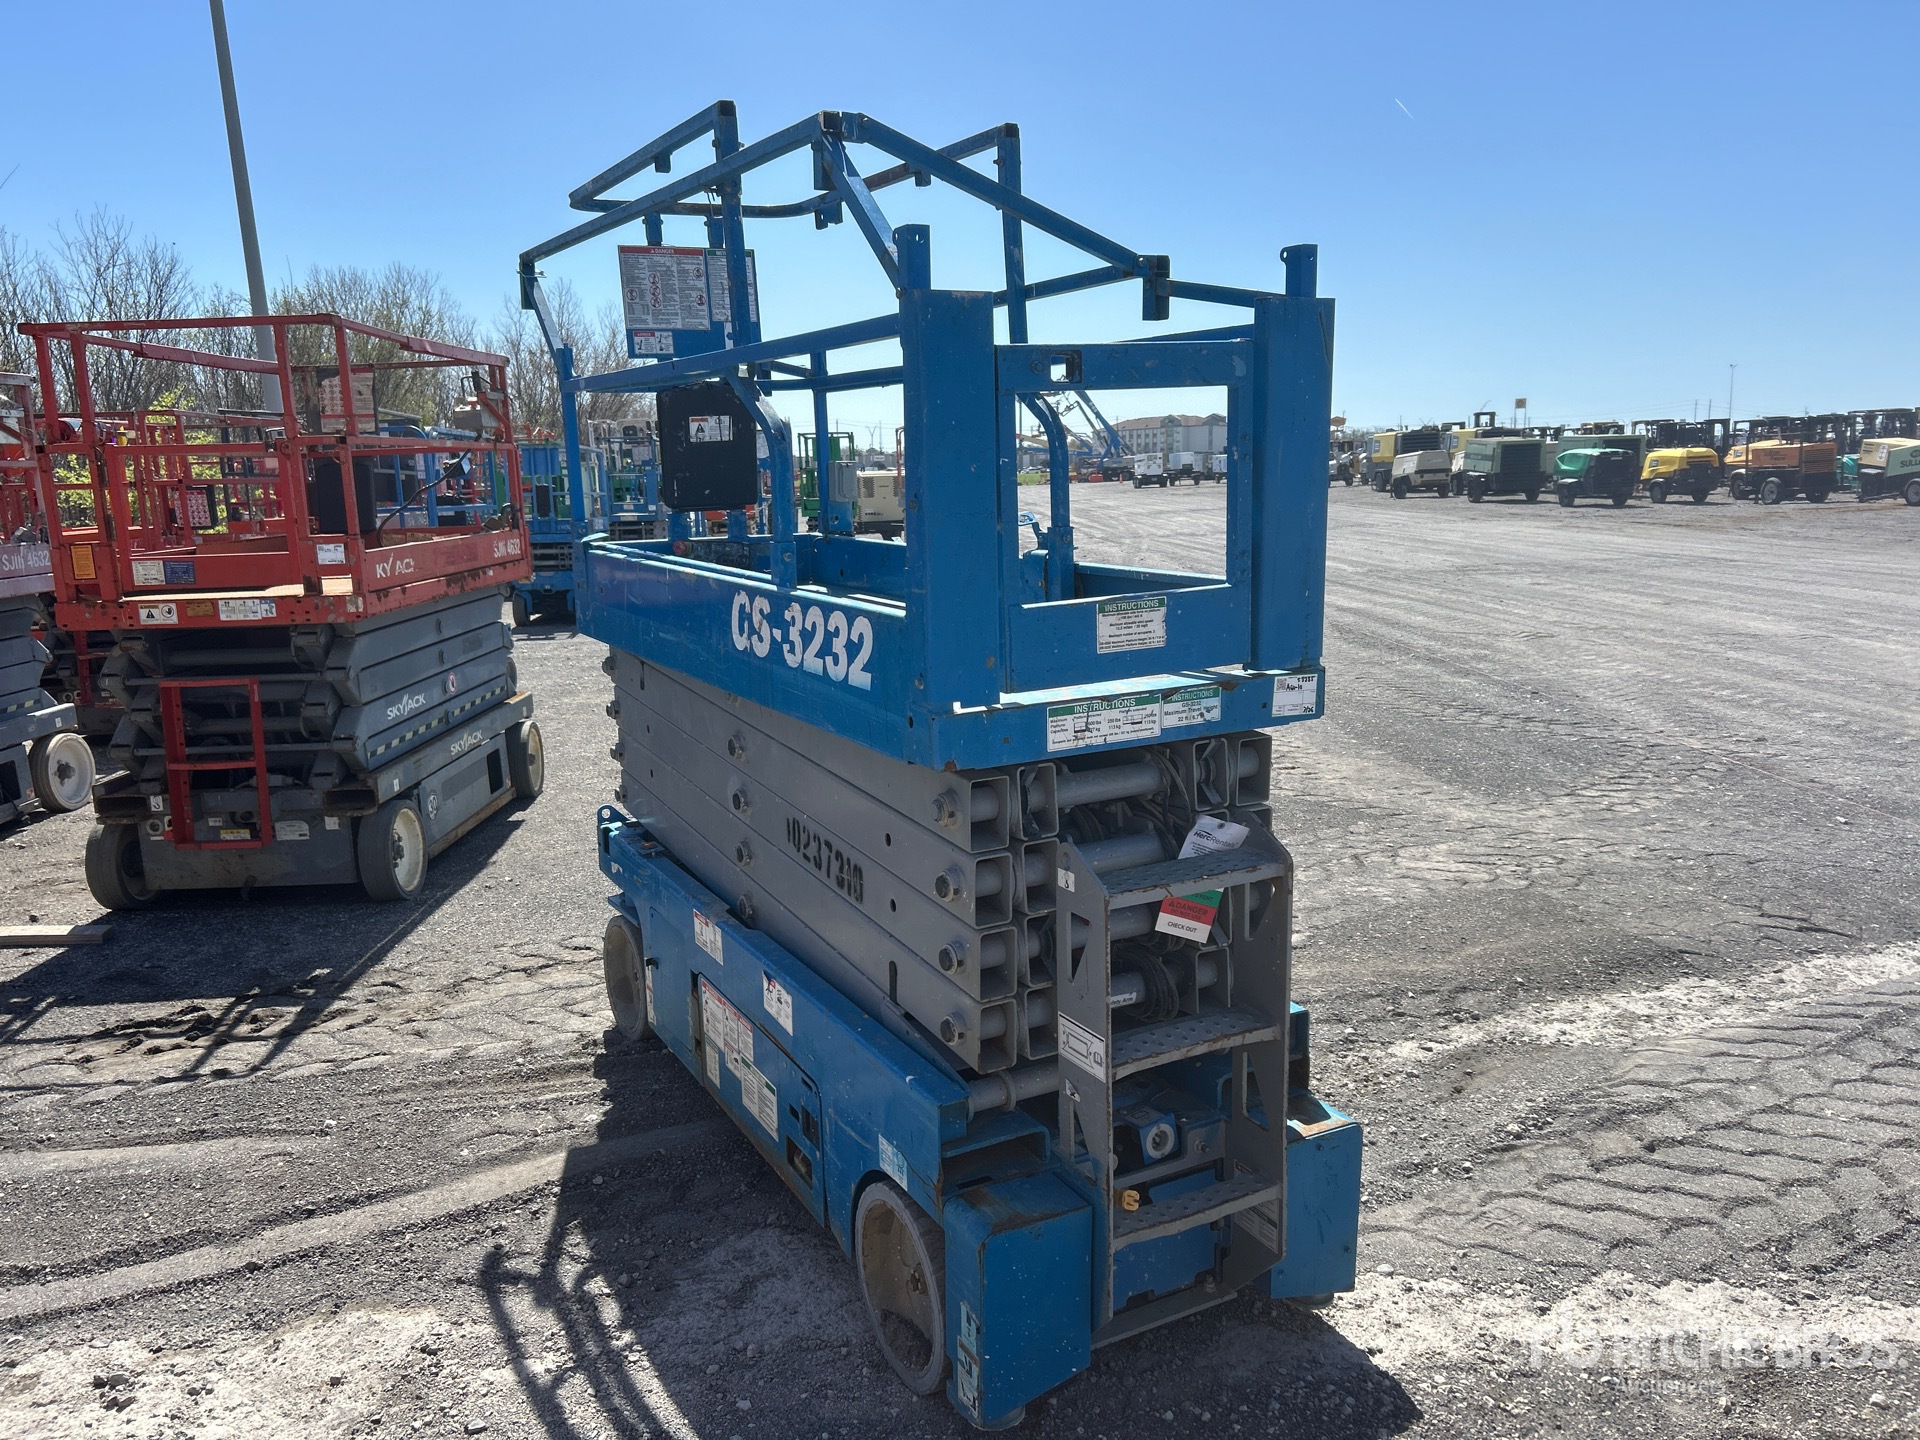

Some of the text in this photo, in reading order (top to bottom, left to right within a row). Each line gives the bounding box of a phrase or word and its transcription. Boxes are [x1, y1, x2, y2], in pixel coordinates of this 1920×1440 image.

[27, 550, 51, 567] 4632
[1104, 599, 1159, 612] INSTRUCTIONS
[1172, 690, 1214, 701] INSTRUCTIONS
[387, 693, 426, 720] SKYJACK
[1074, 698, 1136, 713] INSTRUCTIONS
[450, 729, 483, 756] SKYJACK
[1175, 902, 1208, 917] DANGER
[1167, 921, 1197, 934] CHECK OUT
